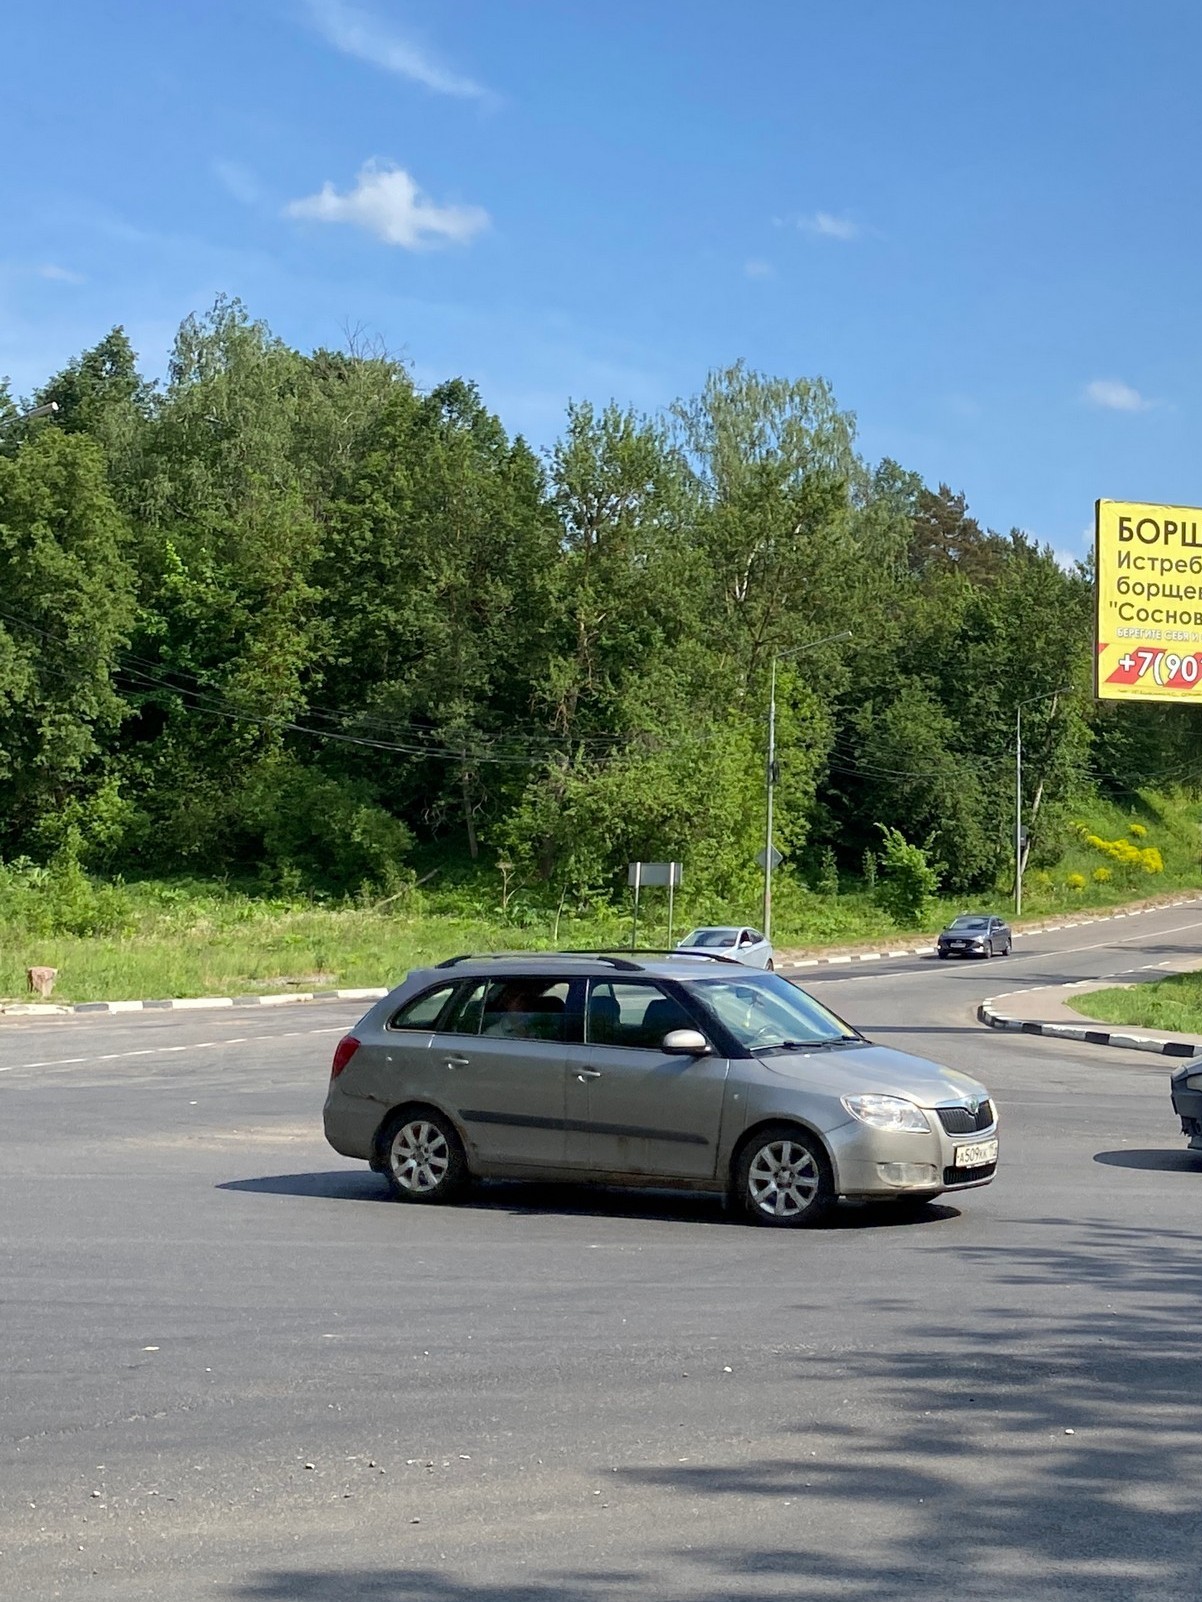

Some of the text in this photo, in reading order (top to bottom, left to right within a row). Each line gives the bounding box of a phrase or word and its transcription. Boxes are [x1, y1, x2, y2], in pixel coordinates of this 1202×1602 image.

[1116, 628, 1161, 639] БЕРЕГИТЕ
[1164, 631, 1190, 641] СЕБЯ
[1191, 633, 1200, 642] И
